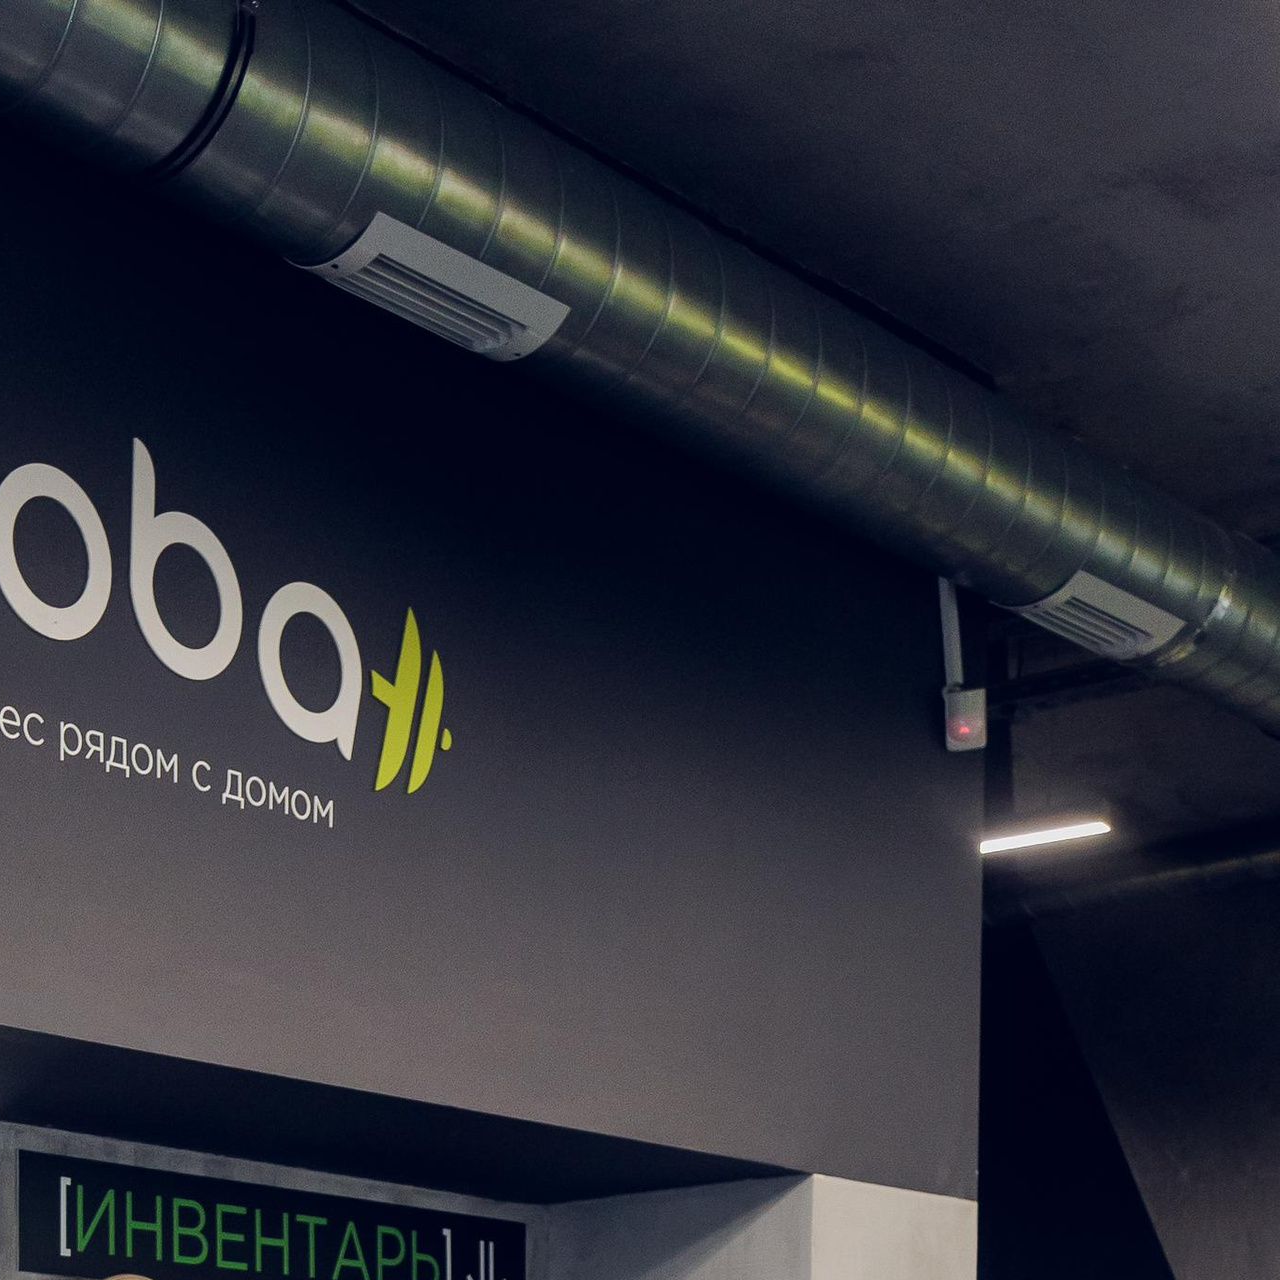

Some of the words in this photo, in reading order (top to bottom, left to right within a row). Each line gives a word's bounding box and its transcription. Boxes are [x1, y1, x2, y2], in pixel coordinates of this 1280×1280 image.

[59, 720, 179, 783] рядом
[191, 760, 212, 792] с
[221, 768, 335, 829] домом
